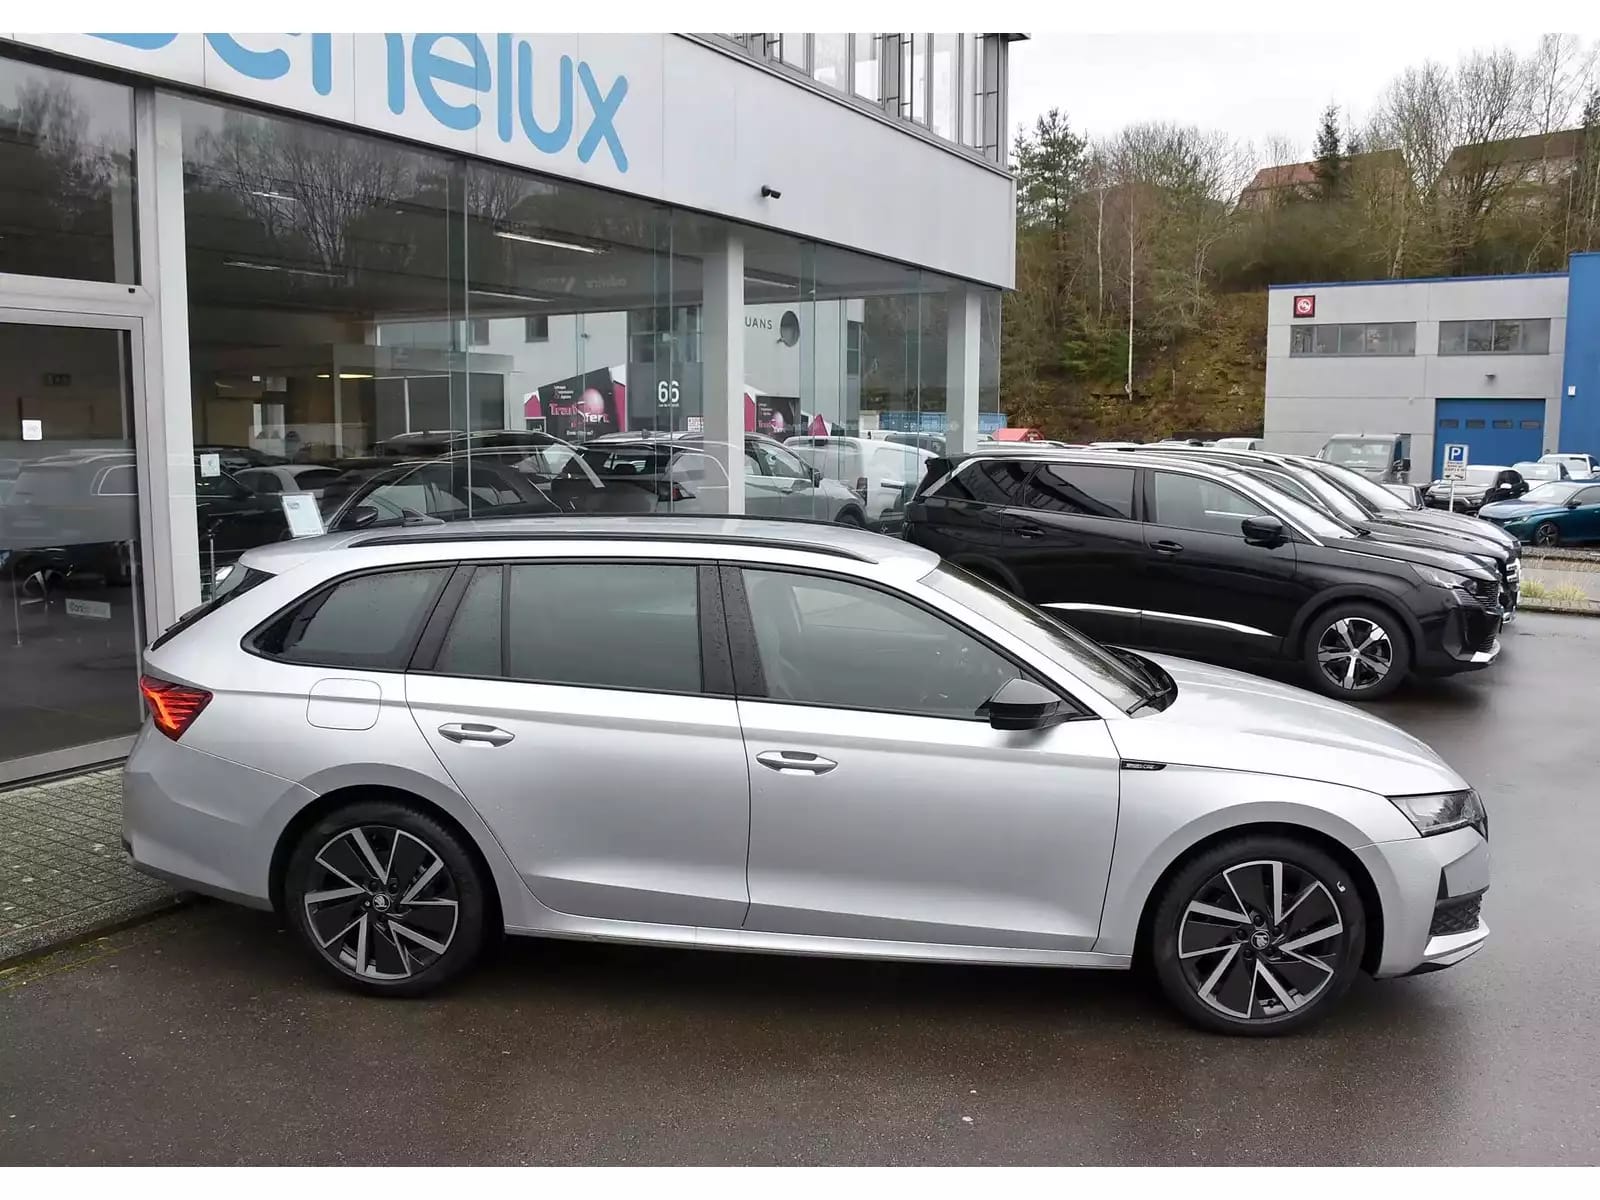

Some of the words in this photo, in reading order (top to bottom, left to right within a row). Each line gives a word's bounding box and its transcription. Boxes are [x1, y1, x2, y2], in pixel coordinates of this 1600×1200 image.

[82, 33, 629, 173] nelux
[658, 380, 680, 403] 66
[1450, 447, 1462, 460] P
